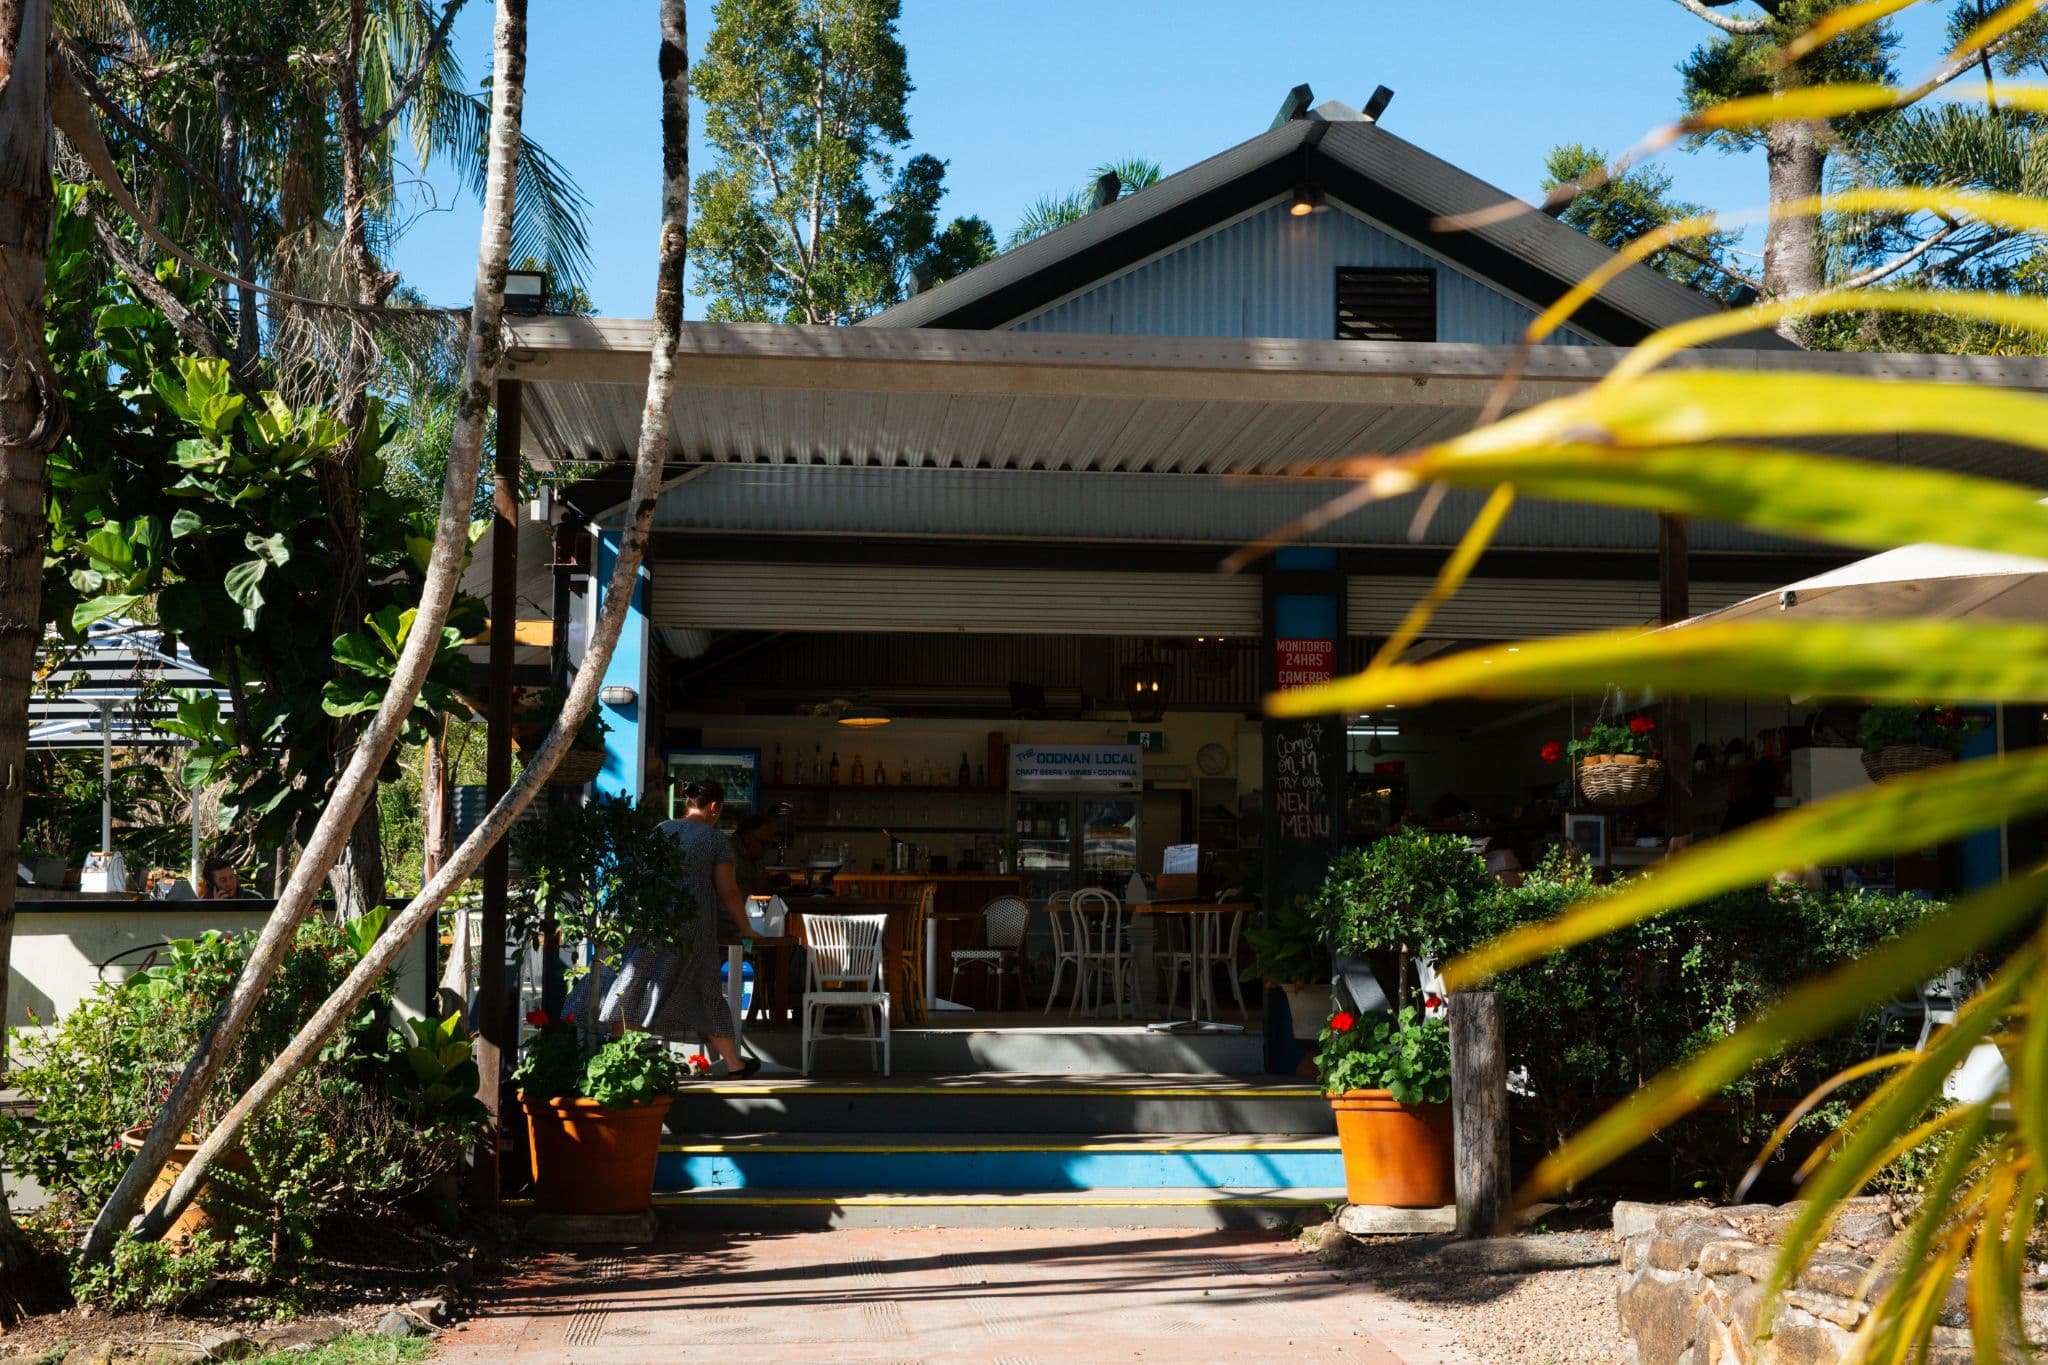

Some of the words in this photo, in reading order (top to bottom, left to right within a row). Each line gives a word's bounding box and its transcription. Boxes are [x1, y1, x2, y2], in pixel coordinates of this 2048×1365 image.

[1277, 640, 1332, 653] MONITORED
[1286, 653, 1323, 666] 24HRS
[1279, 671, 1330, 685] CAMERAS
[1277, 733, 1313, 758] Come
[1016, 748, 1036, 762] THE
[1095, 752, 1137, 764] LOCAL
[1016, 768, 1039, 776] CRAFT
[1040, 768, 1063, 776] BEERS
[1069, 768, 1092, 776] WINES
[1098, 768, 1137, 776] COCKTAILS
[1277, 775, 1298, 788] TRY
[1302, 775, 1324, 788] OUR
[1277, 791, 1310, 812] NEW
[1281, 813, 1331, 838] MENU
